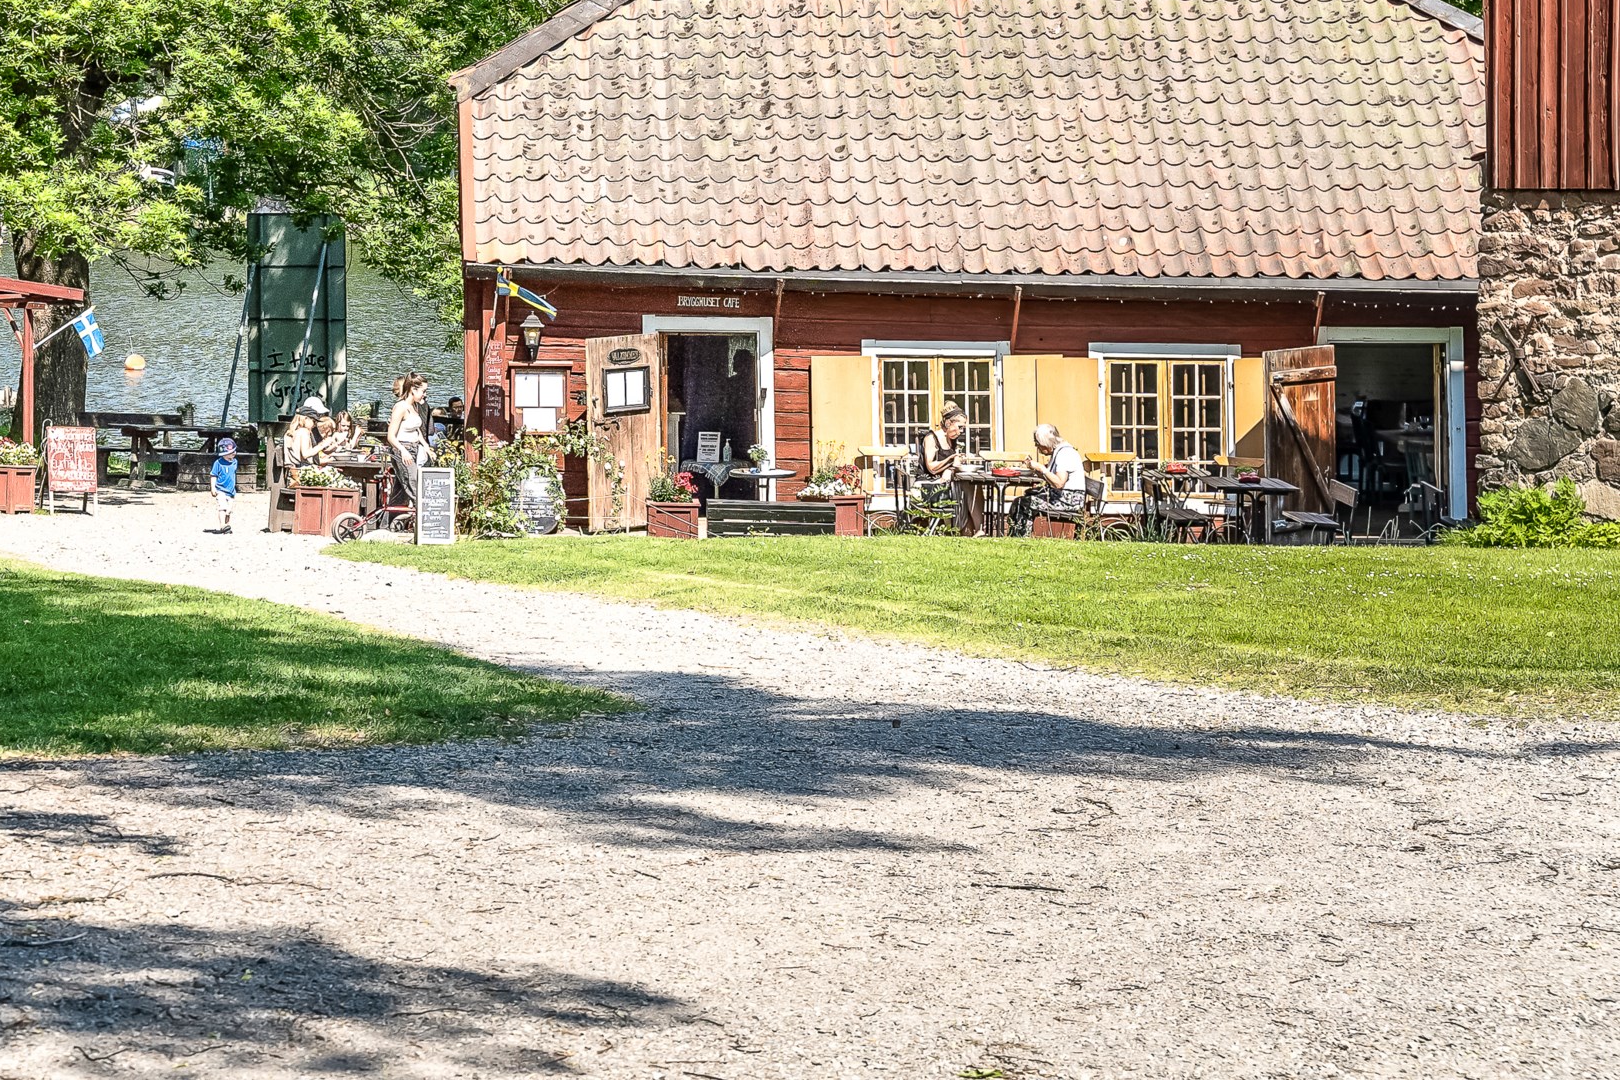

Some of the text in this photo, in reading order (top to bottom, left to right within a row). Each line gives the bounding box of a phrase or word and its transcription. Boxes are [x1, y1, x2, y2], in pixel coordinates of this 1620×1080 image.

[677, 295, 740, 308] BRYGGHUSET CAFE
[289, 350, 329, 370] Hate
